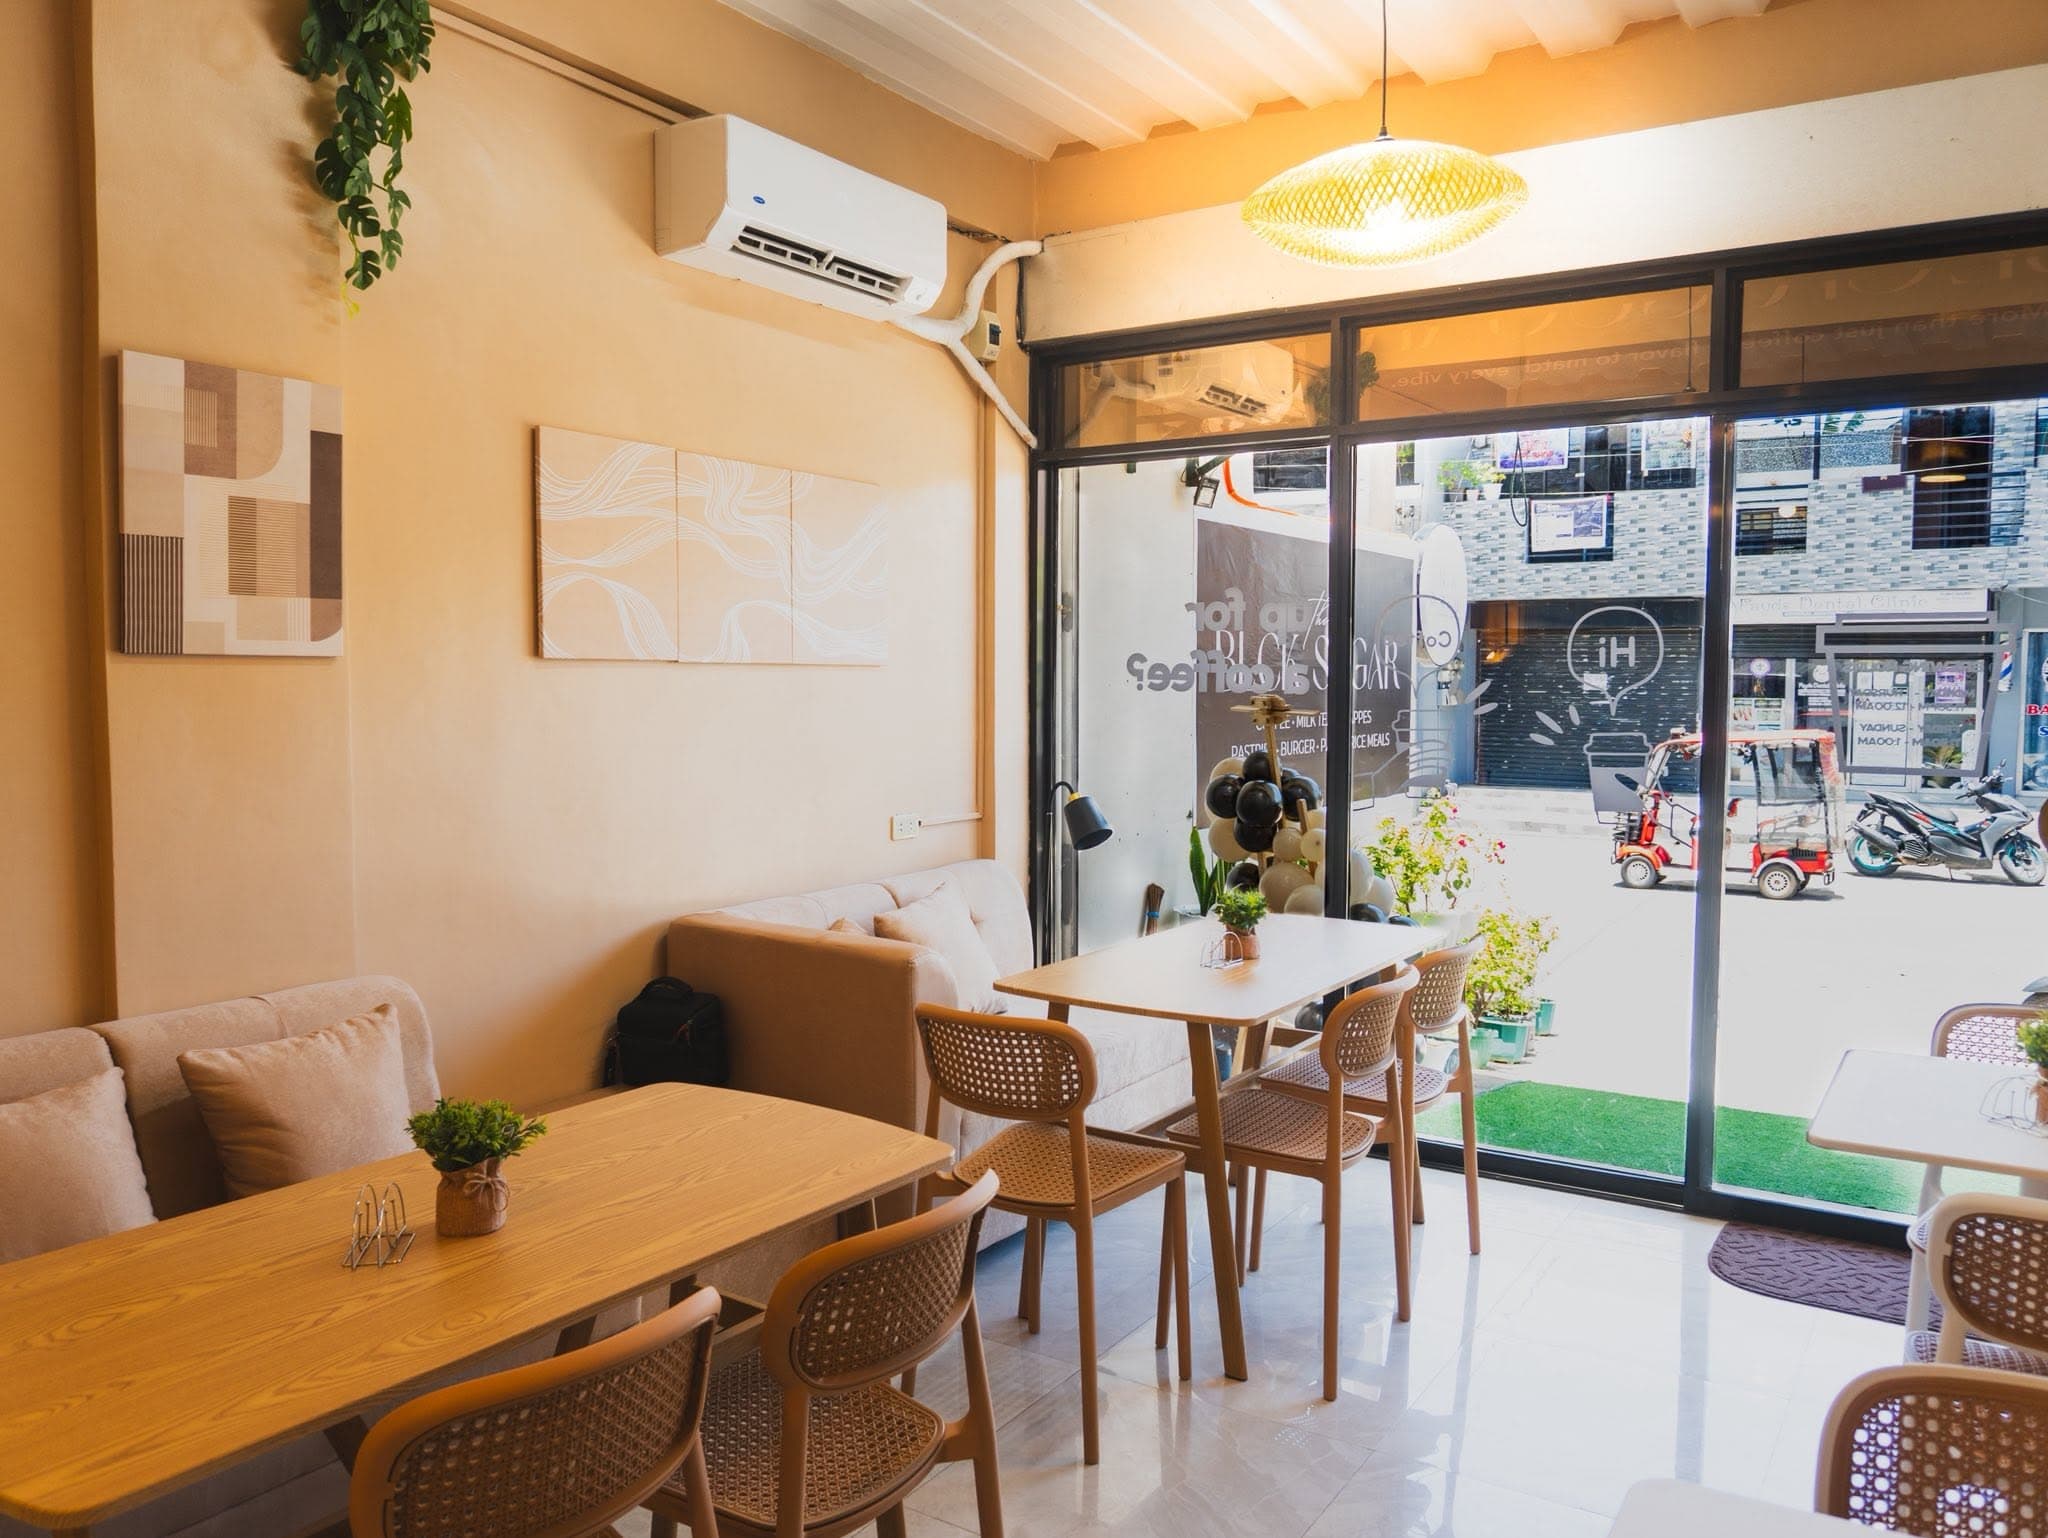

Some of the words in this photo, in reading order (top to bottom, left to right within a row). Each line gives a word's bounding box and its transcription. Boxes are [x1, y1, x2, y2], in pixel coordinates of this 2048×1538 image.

[1870, 595, 1929, 609] Clinic
[1280, 738, 1316, 756] BURGER
[1367, 732, 1391, 747] MEALS
